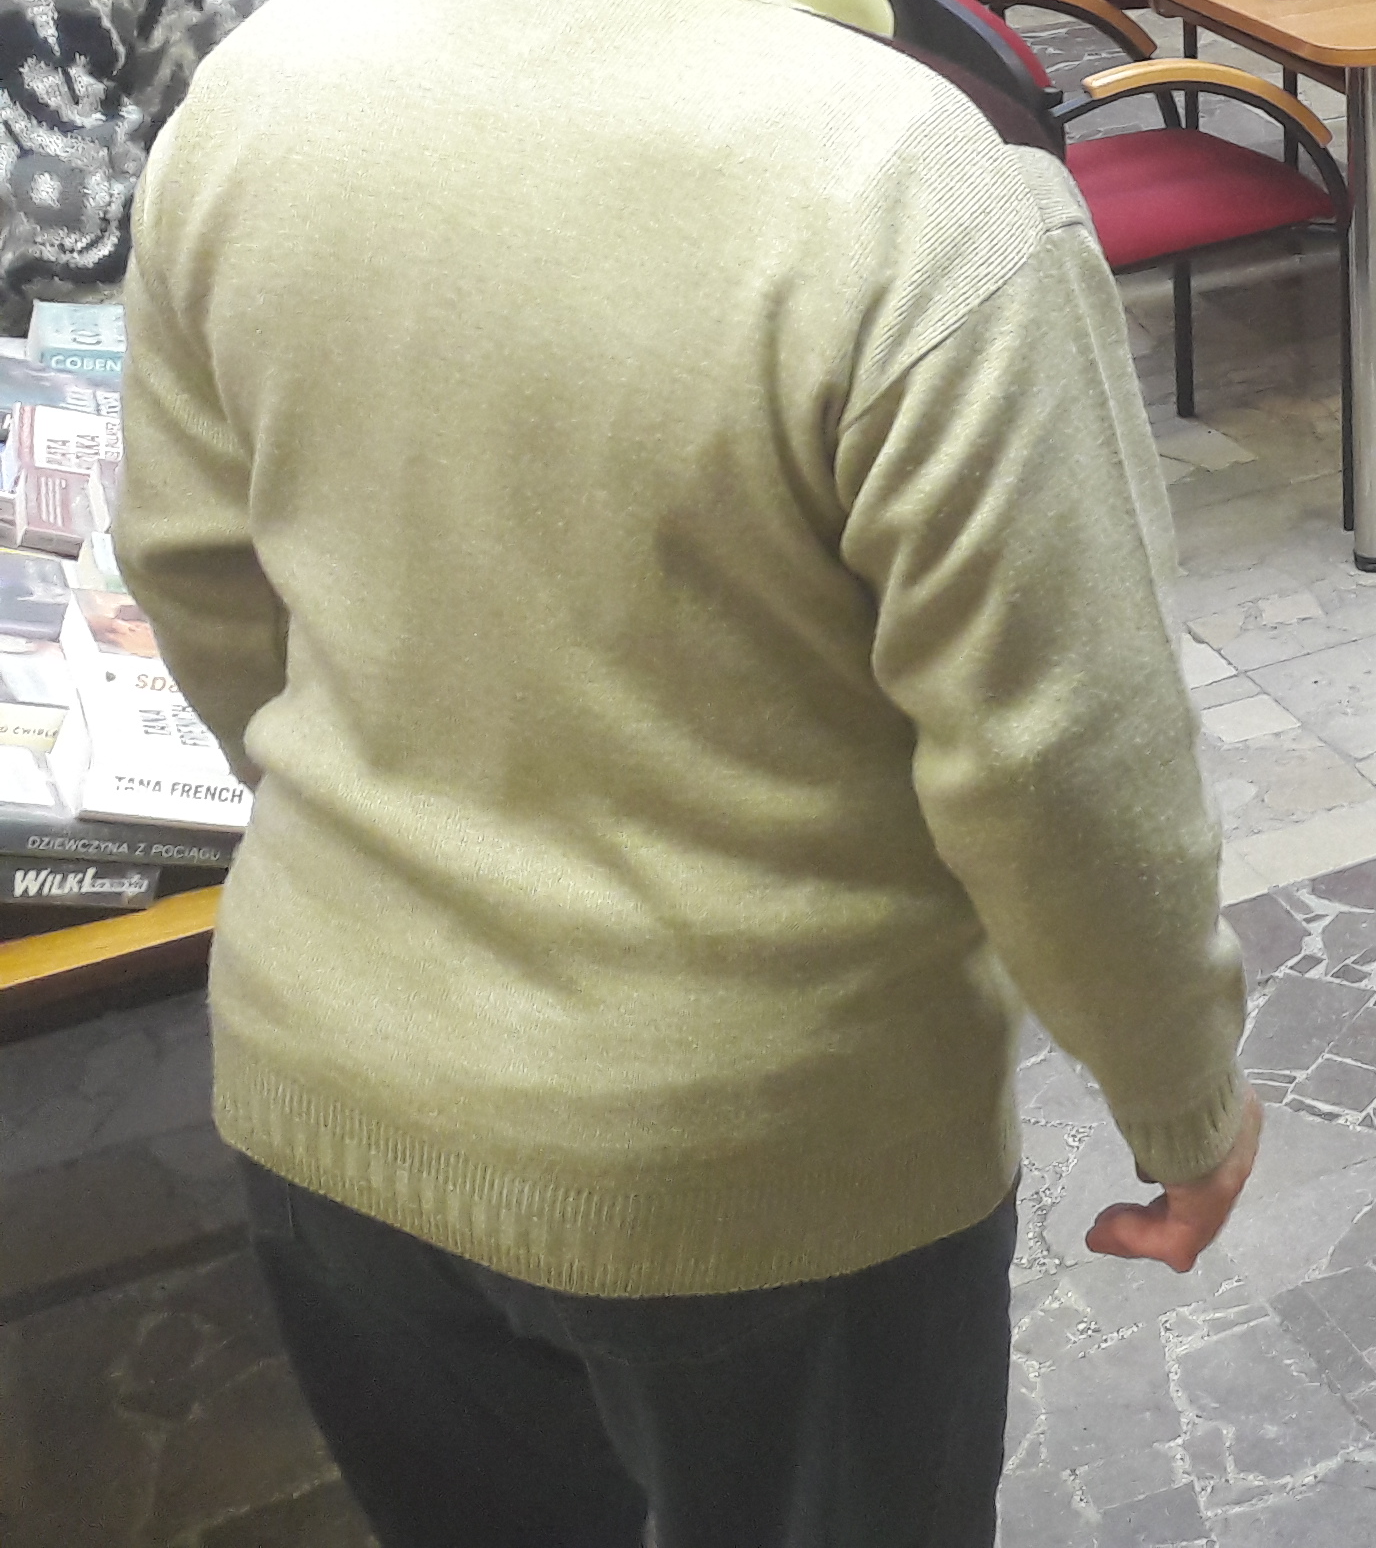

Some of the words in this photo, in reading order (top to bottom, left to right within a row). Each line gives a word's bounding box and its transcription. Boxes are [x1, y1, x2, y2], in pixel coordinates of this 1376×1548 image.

[51, 354, 122, 372] COBEN
[115, 775, 162, 792] TANA
[170, 781, 244, 804] FRENCH
[27, 835, 129, 854] DZIEWCZYNA
[134, 842, 149, 856] Z
